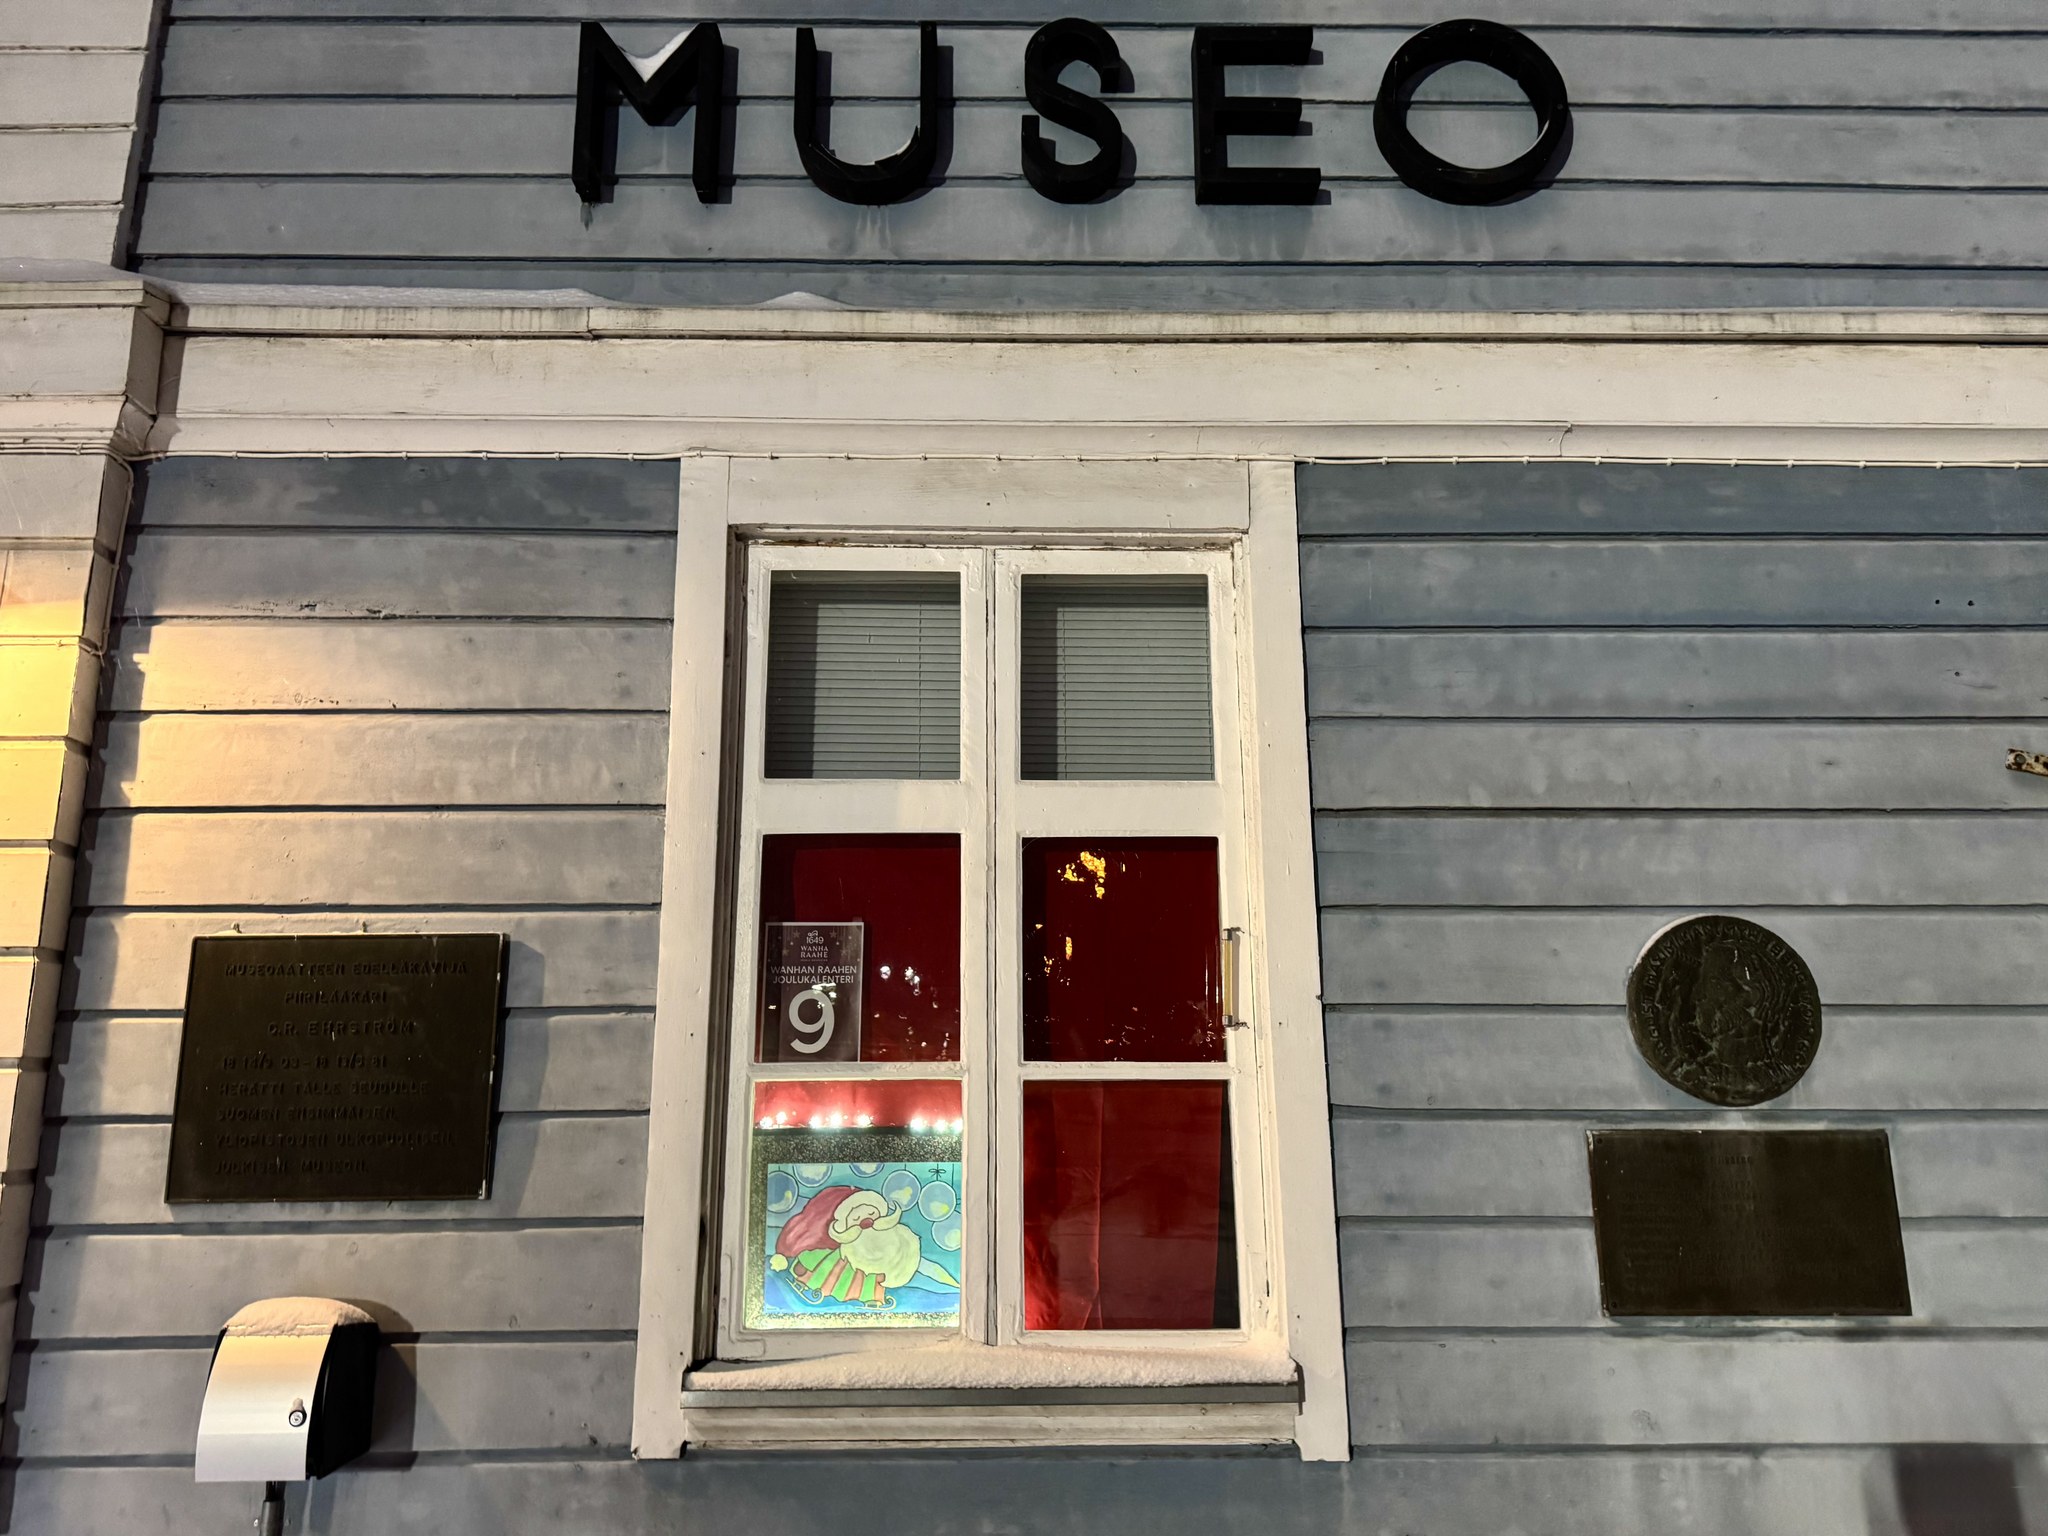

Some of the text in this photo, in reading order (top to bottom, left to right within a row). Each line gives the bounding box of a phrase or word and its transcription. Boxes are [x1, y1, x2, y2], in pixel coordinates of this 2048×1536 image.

[572, 18, 1568, 206] MUSEO
[806, 936, 824, 945] 1649
[770, 965, 857, 974] WANHAN RAAHEN
[773, 975, 854, 984] JOULUKALENTERI
[307, 1017, 413, 1037] EHRSTRÖM
[788, 989, 835, 1054] 9
